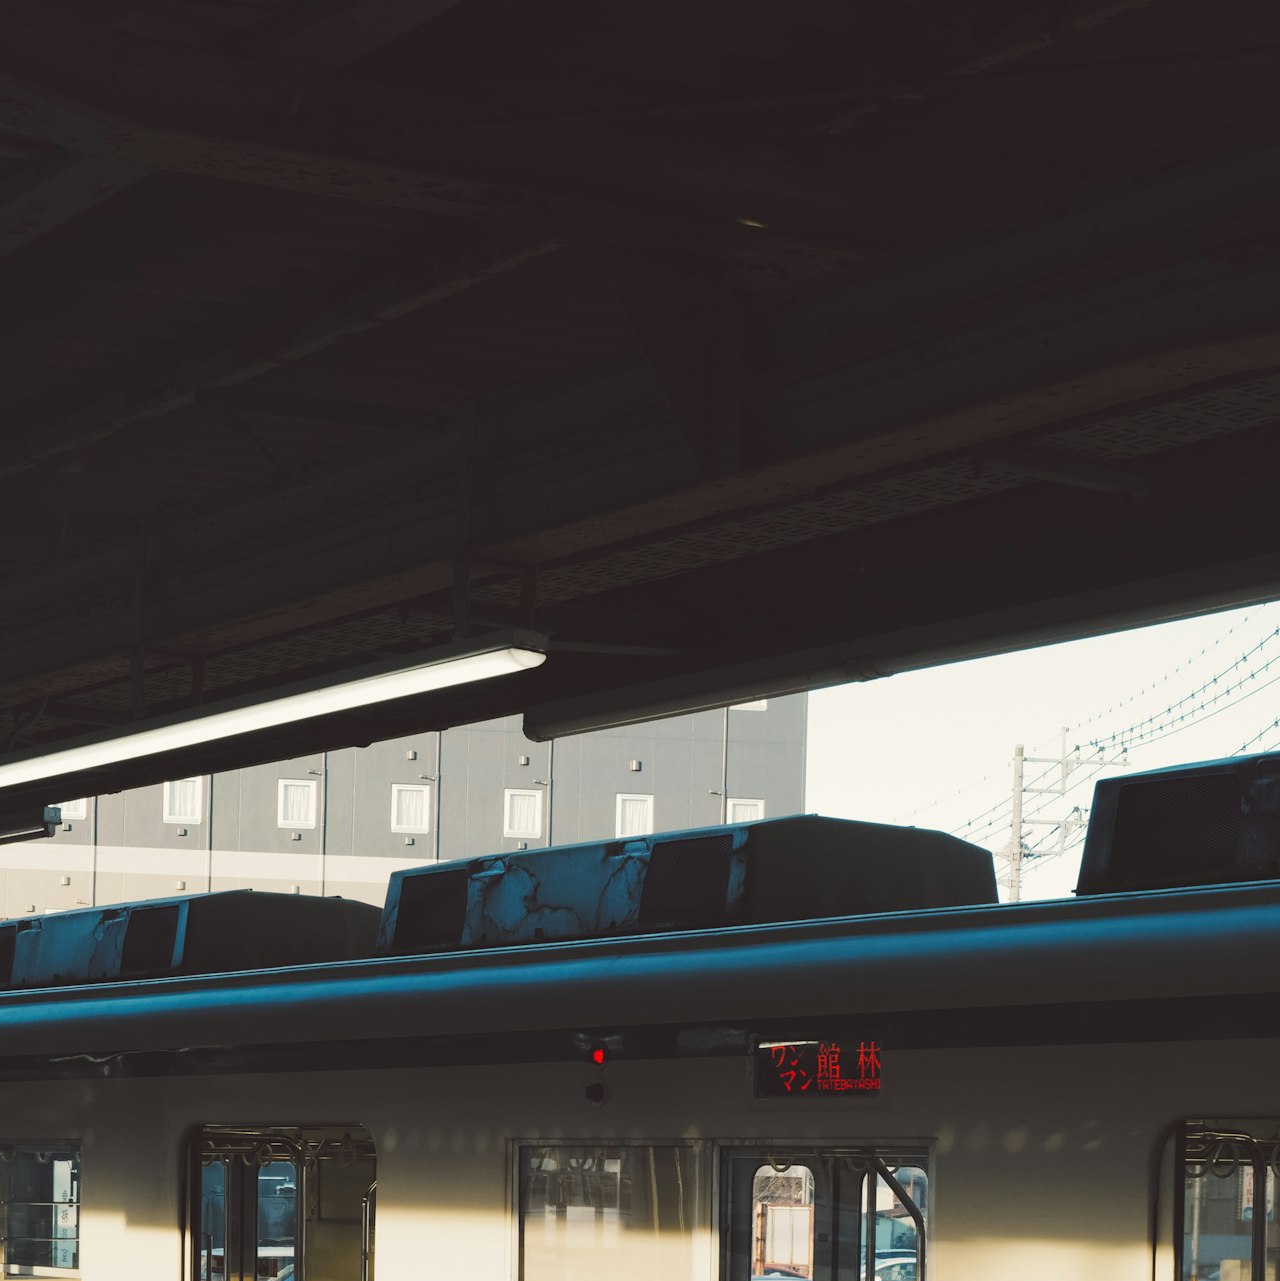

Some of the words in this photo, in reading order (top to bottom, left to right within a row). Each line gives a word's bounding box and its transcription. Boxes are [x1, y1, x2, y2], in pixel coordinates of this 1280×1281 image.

[771, 1045, 805, 1068] ワン
[816, 1041, 881, 1078] 館林
[779, 1069, 815, 1092] マン
[816, 1078, 881, 1090] TATEBAYASHI
